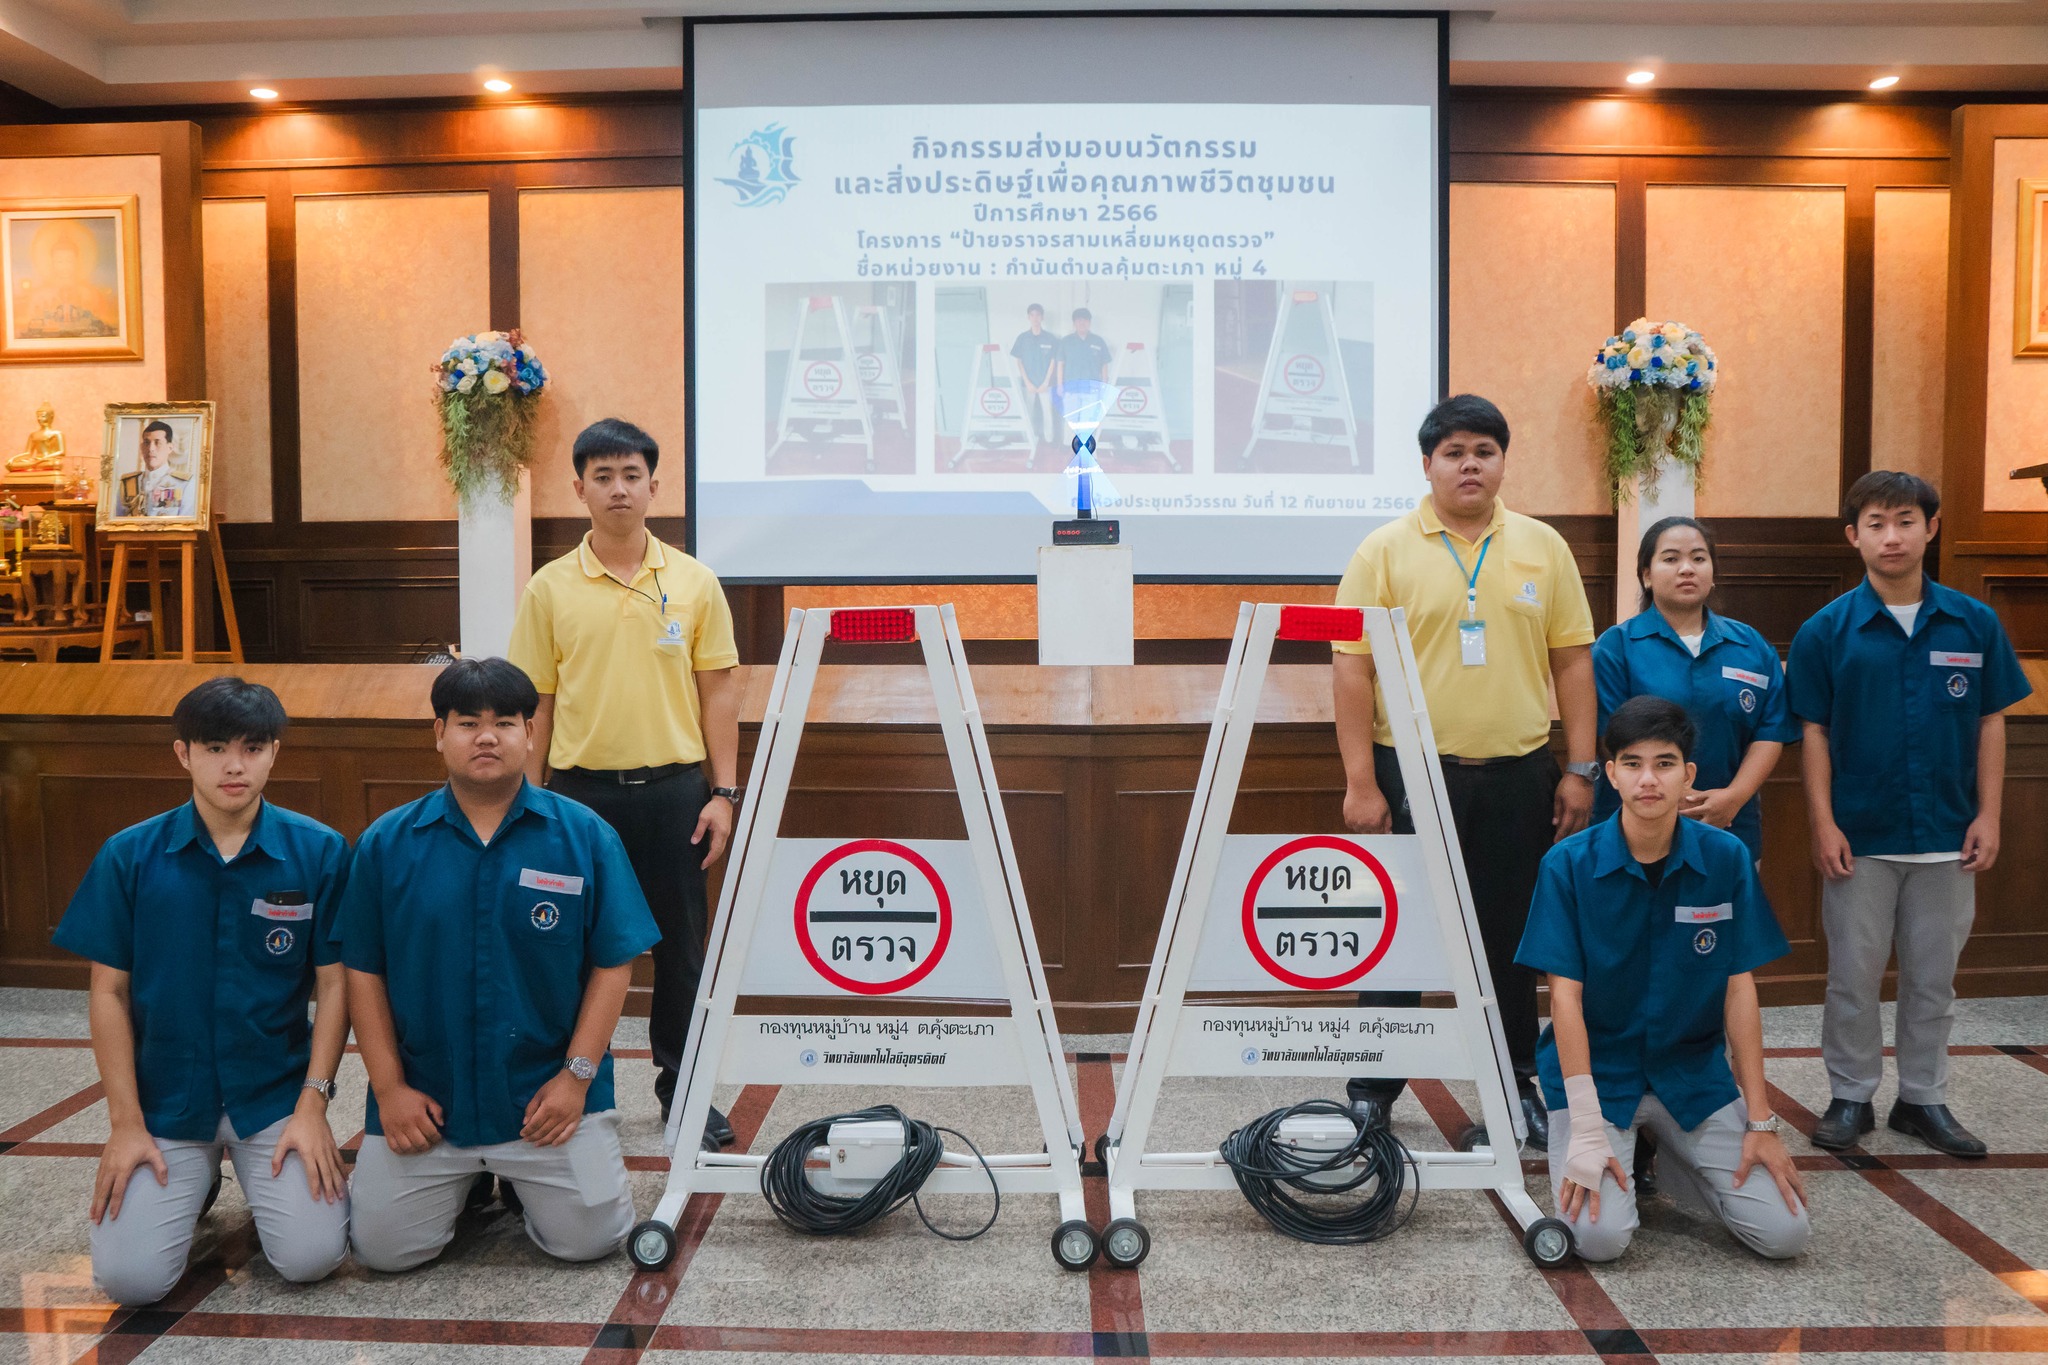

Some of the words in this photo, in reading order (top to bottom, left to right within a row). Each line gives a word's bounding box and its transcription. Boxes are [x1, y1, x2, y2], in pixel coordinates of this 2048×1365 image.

[912, 131, 1257, 159] กิจกรรมส่งมอบนวัตกรรม
[834, 160, 1335, 201] และสิ่งประดิษฐ์เพื่อคุณภาพชีวิตชุมชน
[973, 202, 1088, 222] ปีการศึกษา
[1096, 203, 1158, 222] 2566
[857, 229, 942, 249] โครงการ
[856, 253, 981, 277] ชื่อหน่วยงาน
[1005, 255, 1205, 281] กำนันตำบลคุ้มตะเภา
[1214, 256, 1243, 280] หมู่
[1252, 259, 1268, 276] 4
[1280, 495, 1298, 509] 12
[1303, 494, 1366, 509] กันยายน
[1372, 496, 1416, 510] 2566
[840, 869, 906, 909] หยุด
[1285, 865, 1351, 904] หยุด
[832, 935, 916, 962] ตรวจ
[1276, 931, 1359, 957] ตรวจ
[759, 1018, 871, 1040] กองทุนหมู่บ้าน
[876, 1020, 909, 1041] หมู่4
[917, 1018, 995, 1041] ต.คุ้งตะเภา
[1203, 1015, 1313, 1038] กองทุนหมู่บ้าน
[1318, 1017, 1351, 1039] หมู่4
[1359, 1017, 1435, 1039] ต.คุ้งตะเภา
[823, 1048, 947, 1068] วิทยาลัยเทคโนโลยีอุตรดิตถ์
[1261, 1045, 1385, 1066] วิทยาลัยเทคโนโลยีอุตรดิตถ์
